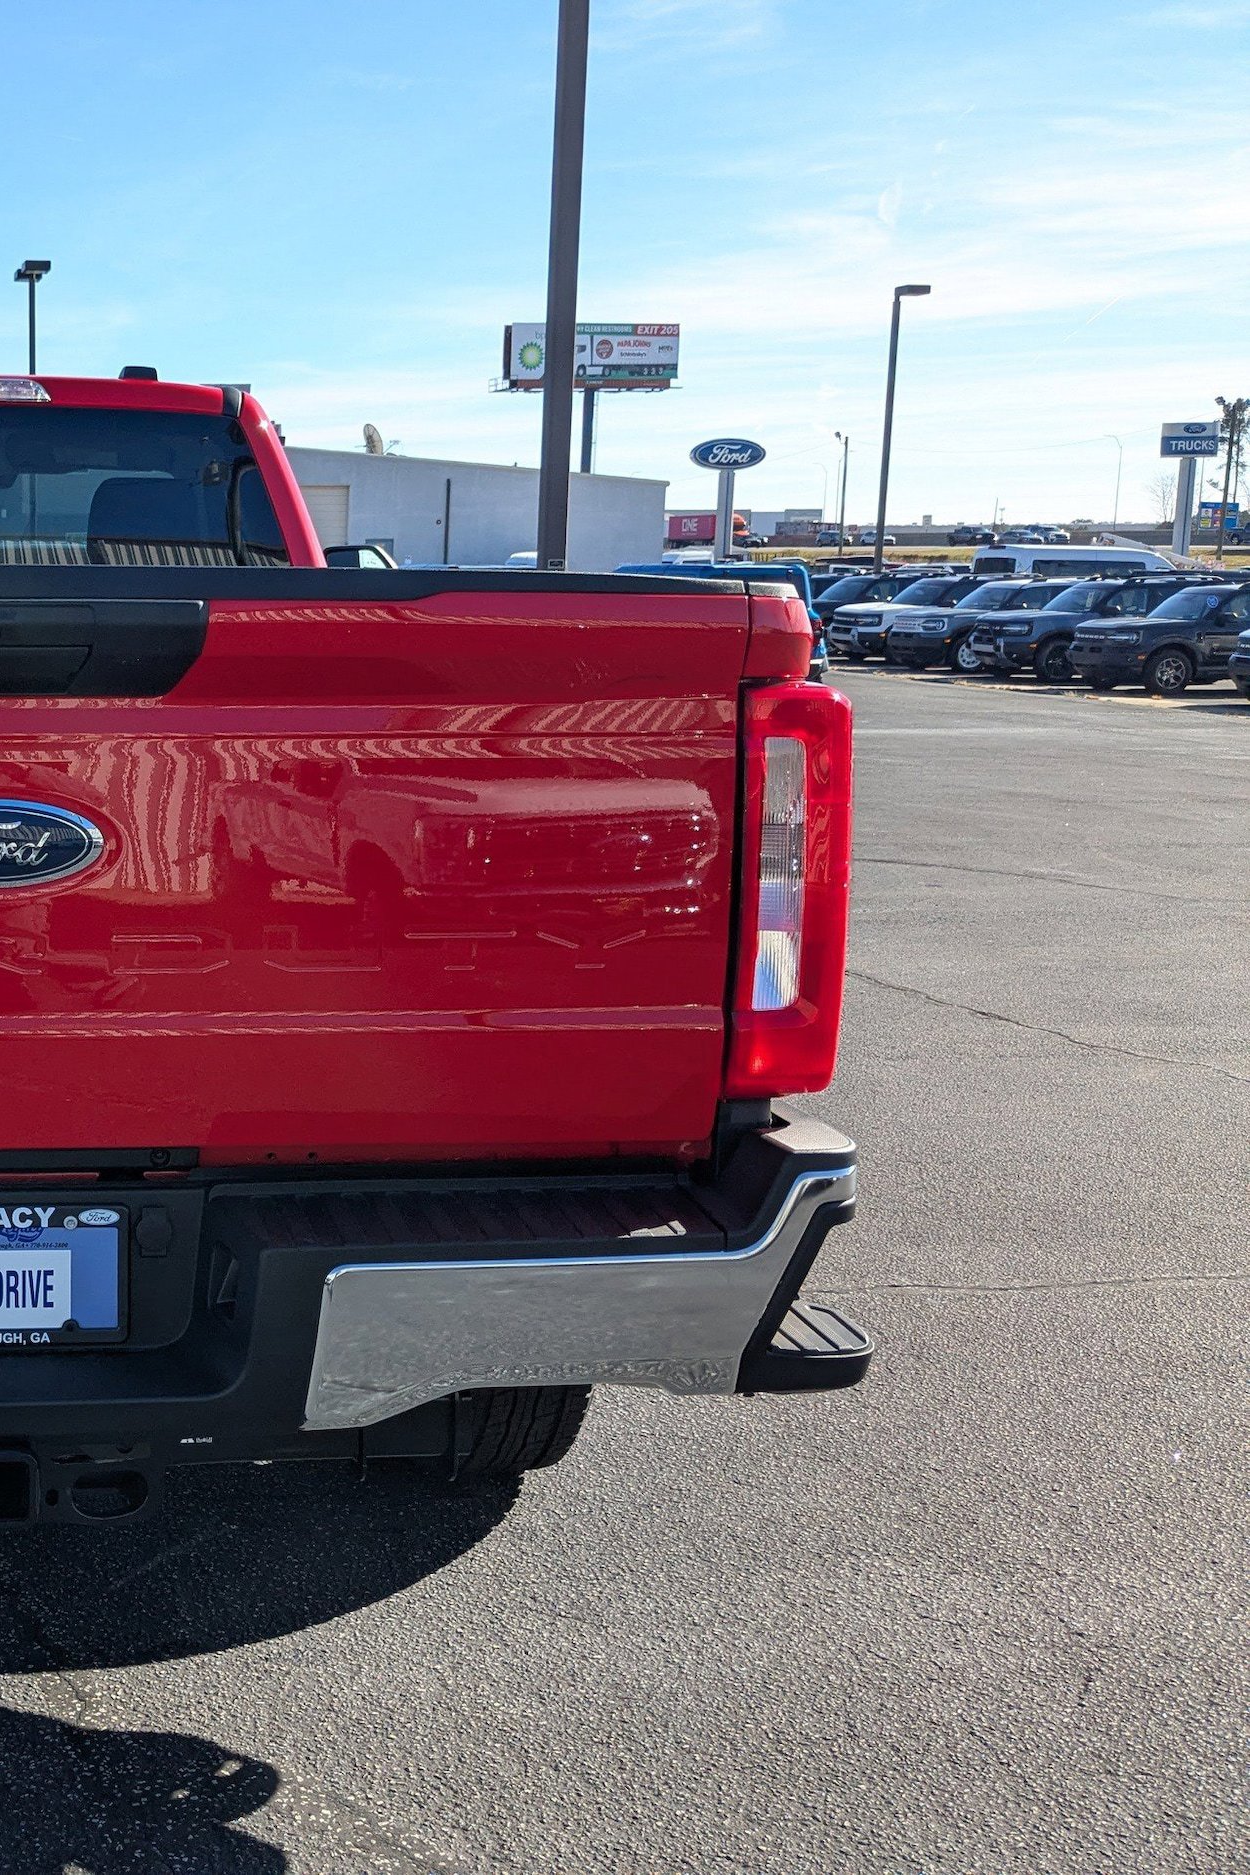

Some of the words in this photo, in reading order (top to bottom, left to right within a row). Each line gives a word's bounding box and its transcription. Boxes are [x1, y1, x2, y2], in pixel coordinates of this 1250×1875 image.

[637, 325, 660, 335] EXIT
[660, 325, 679, 335] 205
[1170, 440, 1215, 451] TRUCKS
[709, 444, 753, 464] Ford
[681, 518, 698, 532] ONE
[110, 925, 648, 977] DUTY
[85, 1212, 113, 1224] Ford
[31, 1332, 51, 1344] GA
